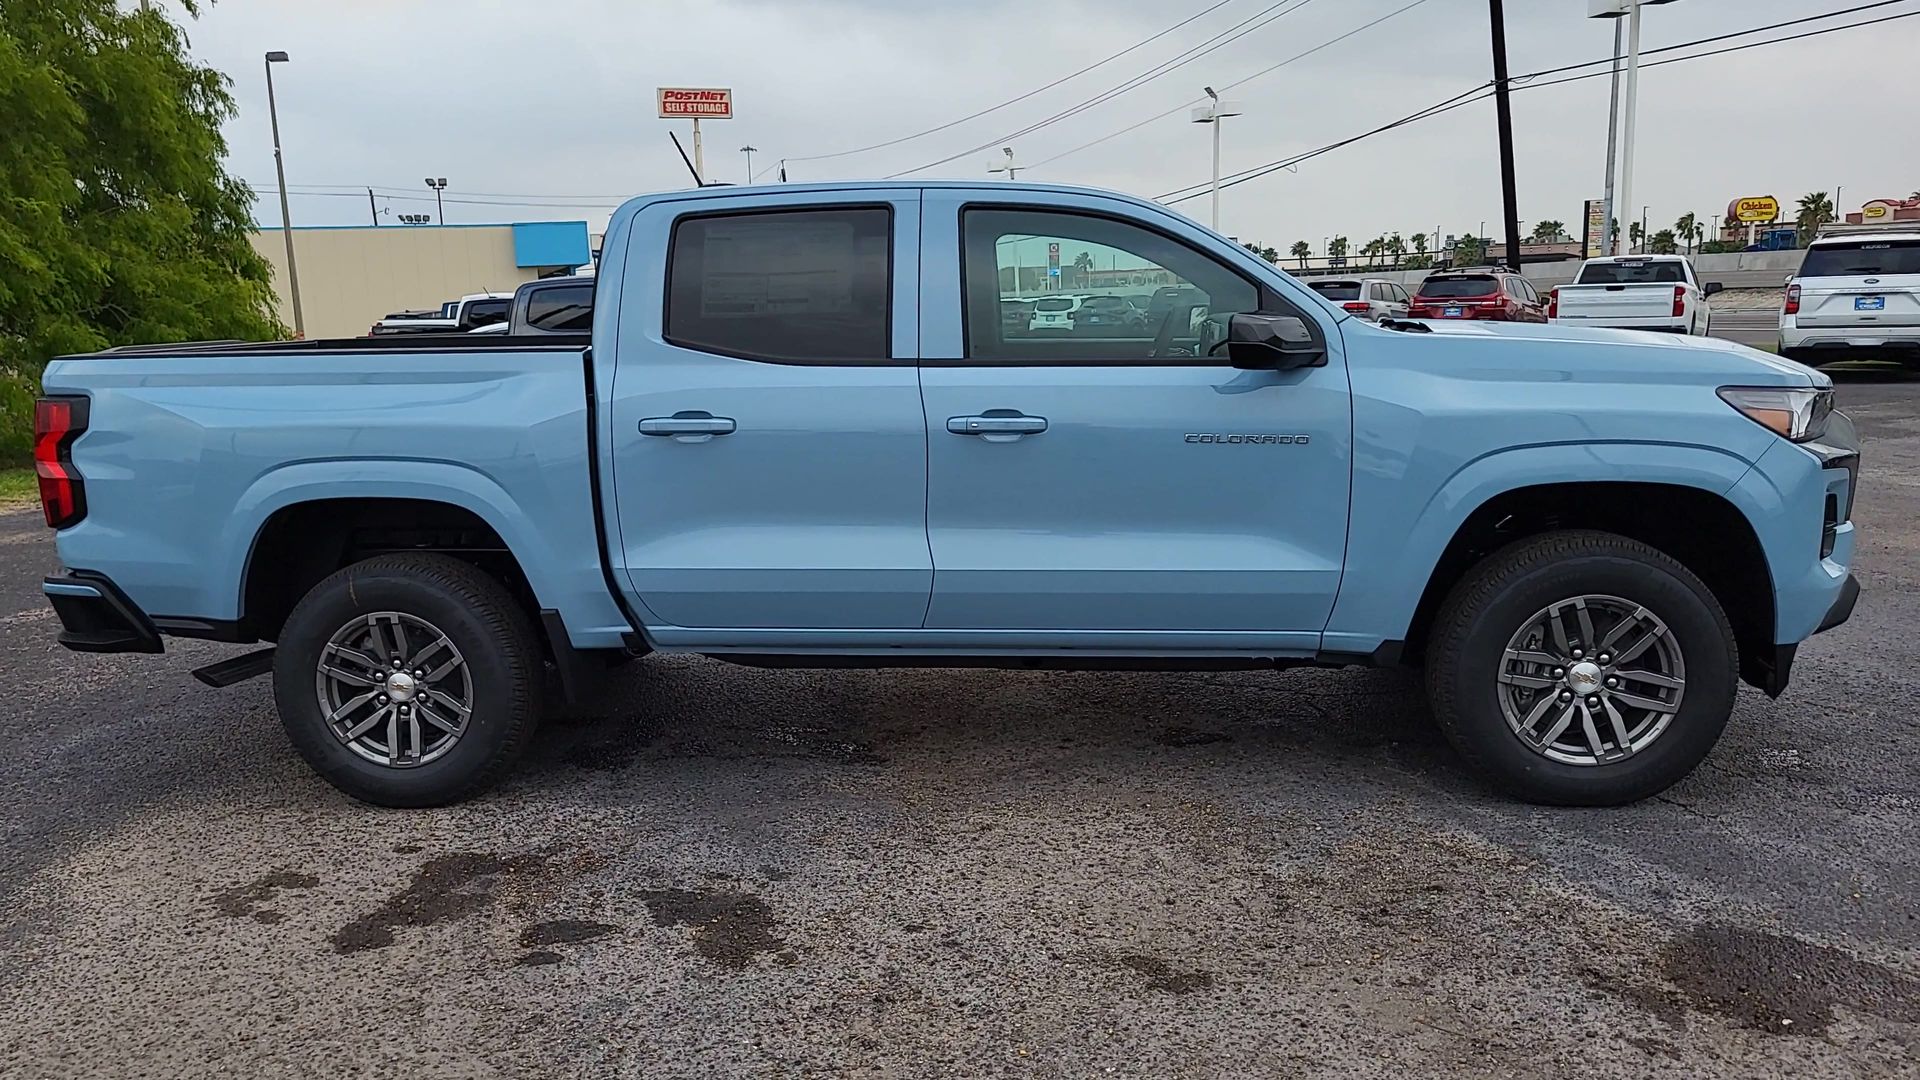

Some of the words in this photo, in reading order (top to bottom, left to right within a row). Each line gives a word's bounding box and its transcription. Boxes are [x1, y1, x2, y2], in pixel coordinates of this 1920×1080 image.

[665, 103, 685, 112] SELF
[686, 103, 727, 113] STORAGE
[1741, 201, 1773, 210] Chicken
[1184, 432, 1310, 445] COLORADO
